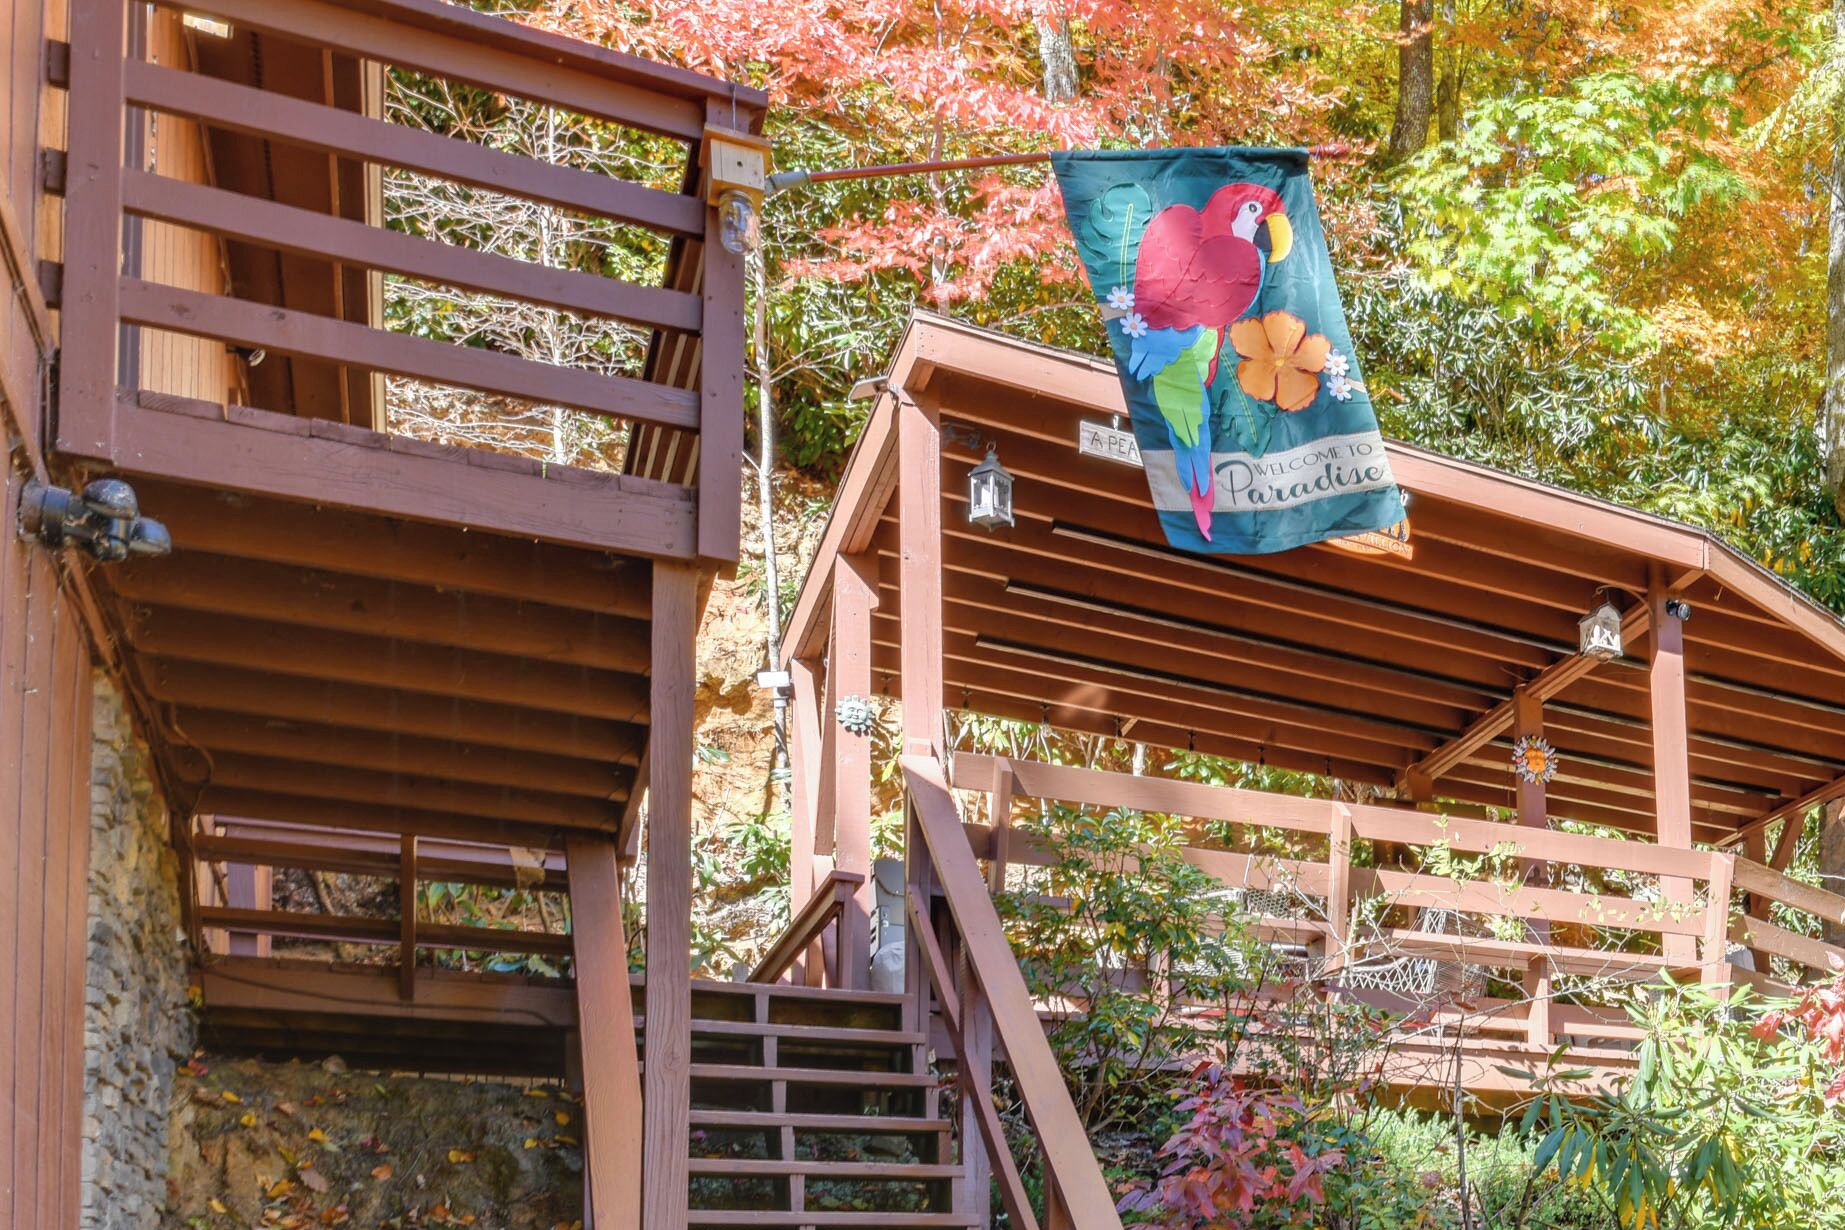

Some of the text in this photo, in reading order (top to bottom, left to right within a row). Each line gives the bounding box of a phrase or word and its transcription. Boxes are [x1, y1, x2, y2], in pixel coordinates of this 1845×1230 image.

[1090, 431, 1104, 450] A
[1253, 443, 1373, 477] WELCOME TO
[1214, 460, 1384, 506] Paradise
